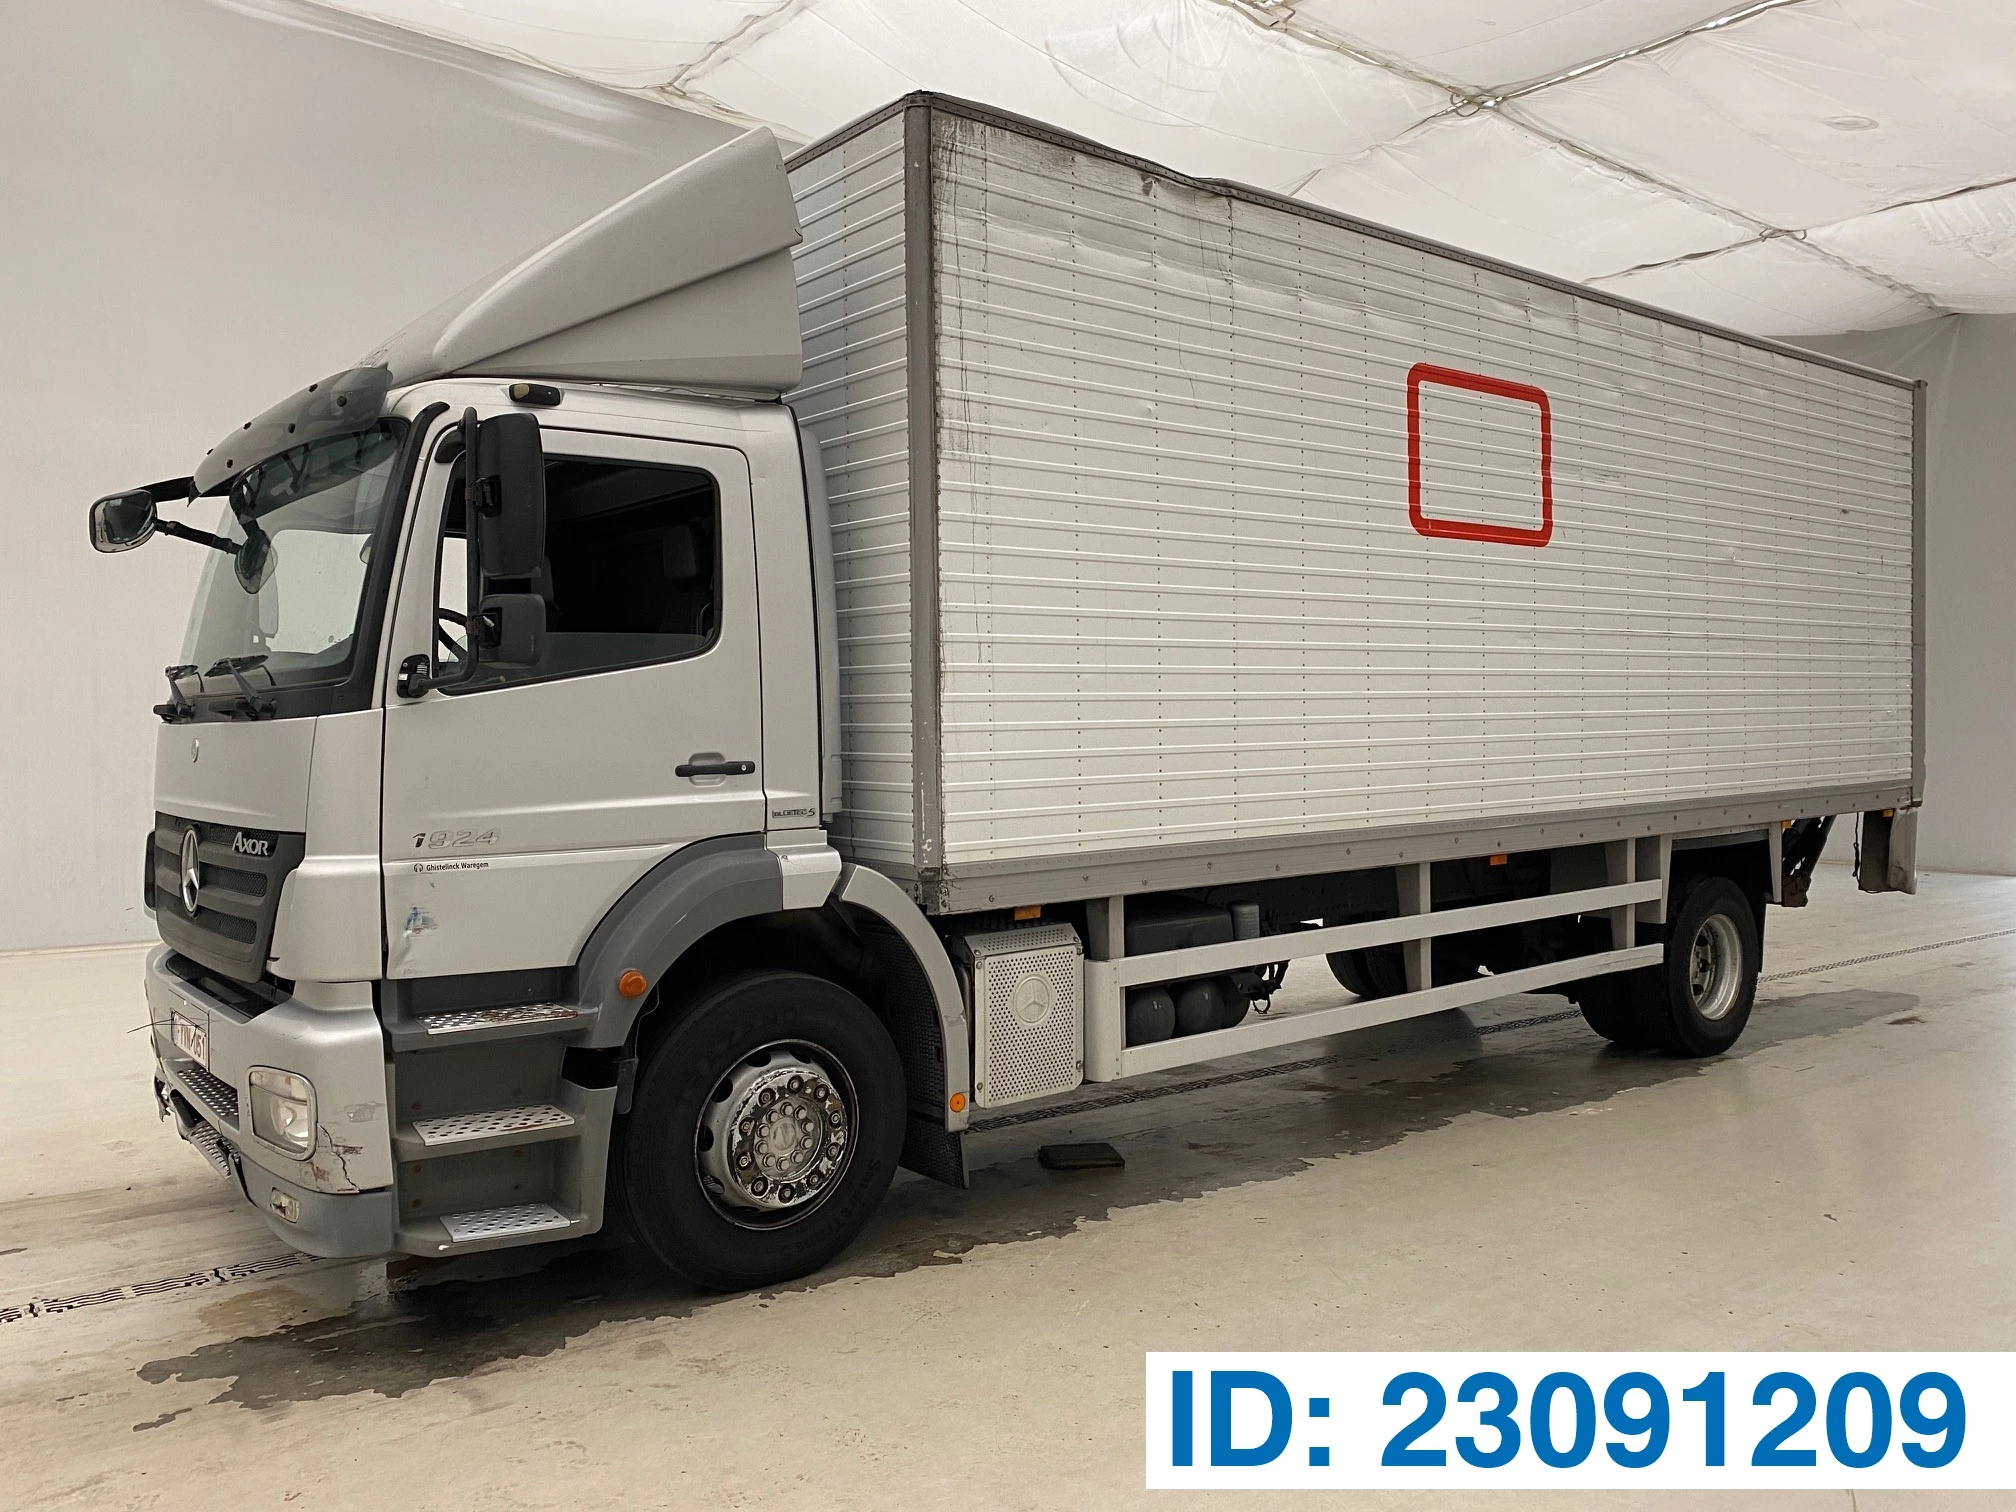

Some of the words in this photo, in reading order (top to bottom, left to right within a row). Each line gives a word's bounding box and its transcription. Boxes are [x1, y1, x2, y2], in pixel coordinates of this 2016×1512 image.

[412, 827, 501, 849] 1924
[426, 862, 460, 872] Ghistelinck
[460, 861, 489, 870] Waregem
